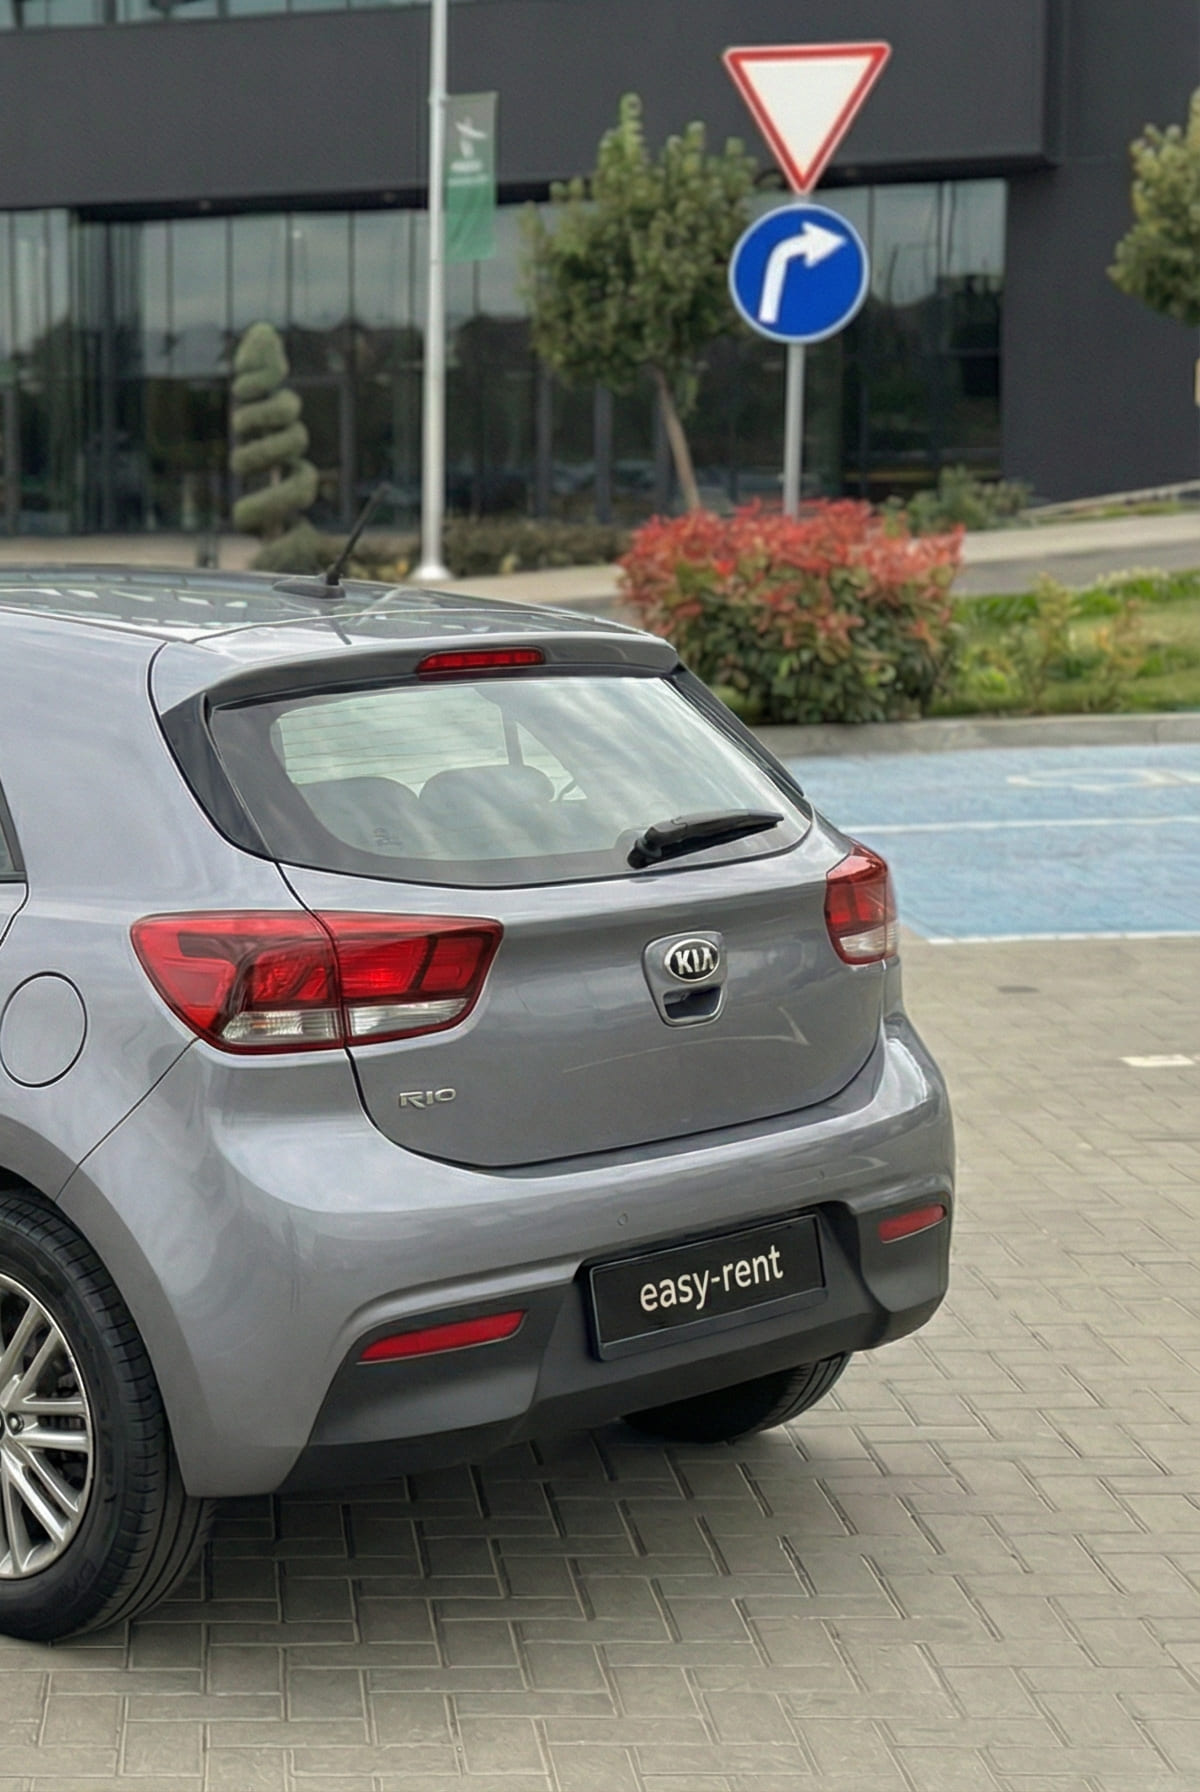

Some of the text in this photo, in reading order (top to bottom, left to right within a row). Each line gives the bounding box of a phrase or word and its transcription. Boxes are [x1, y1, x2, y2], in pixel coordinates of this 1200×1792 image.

[675, 947, 714, 974] KIA
[399, 1088, 456, 1108] RIO
[639, 1244, 784, 1312] easy-rent
